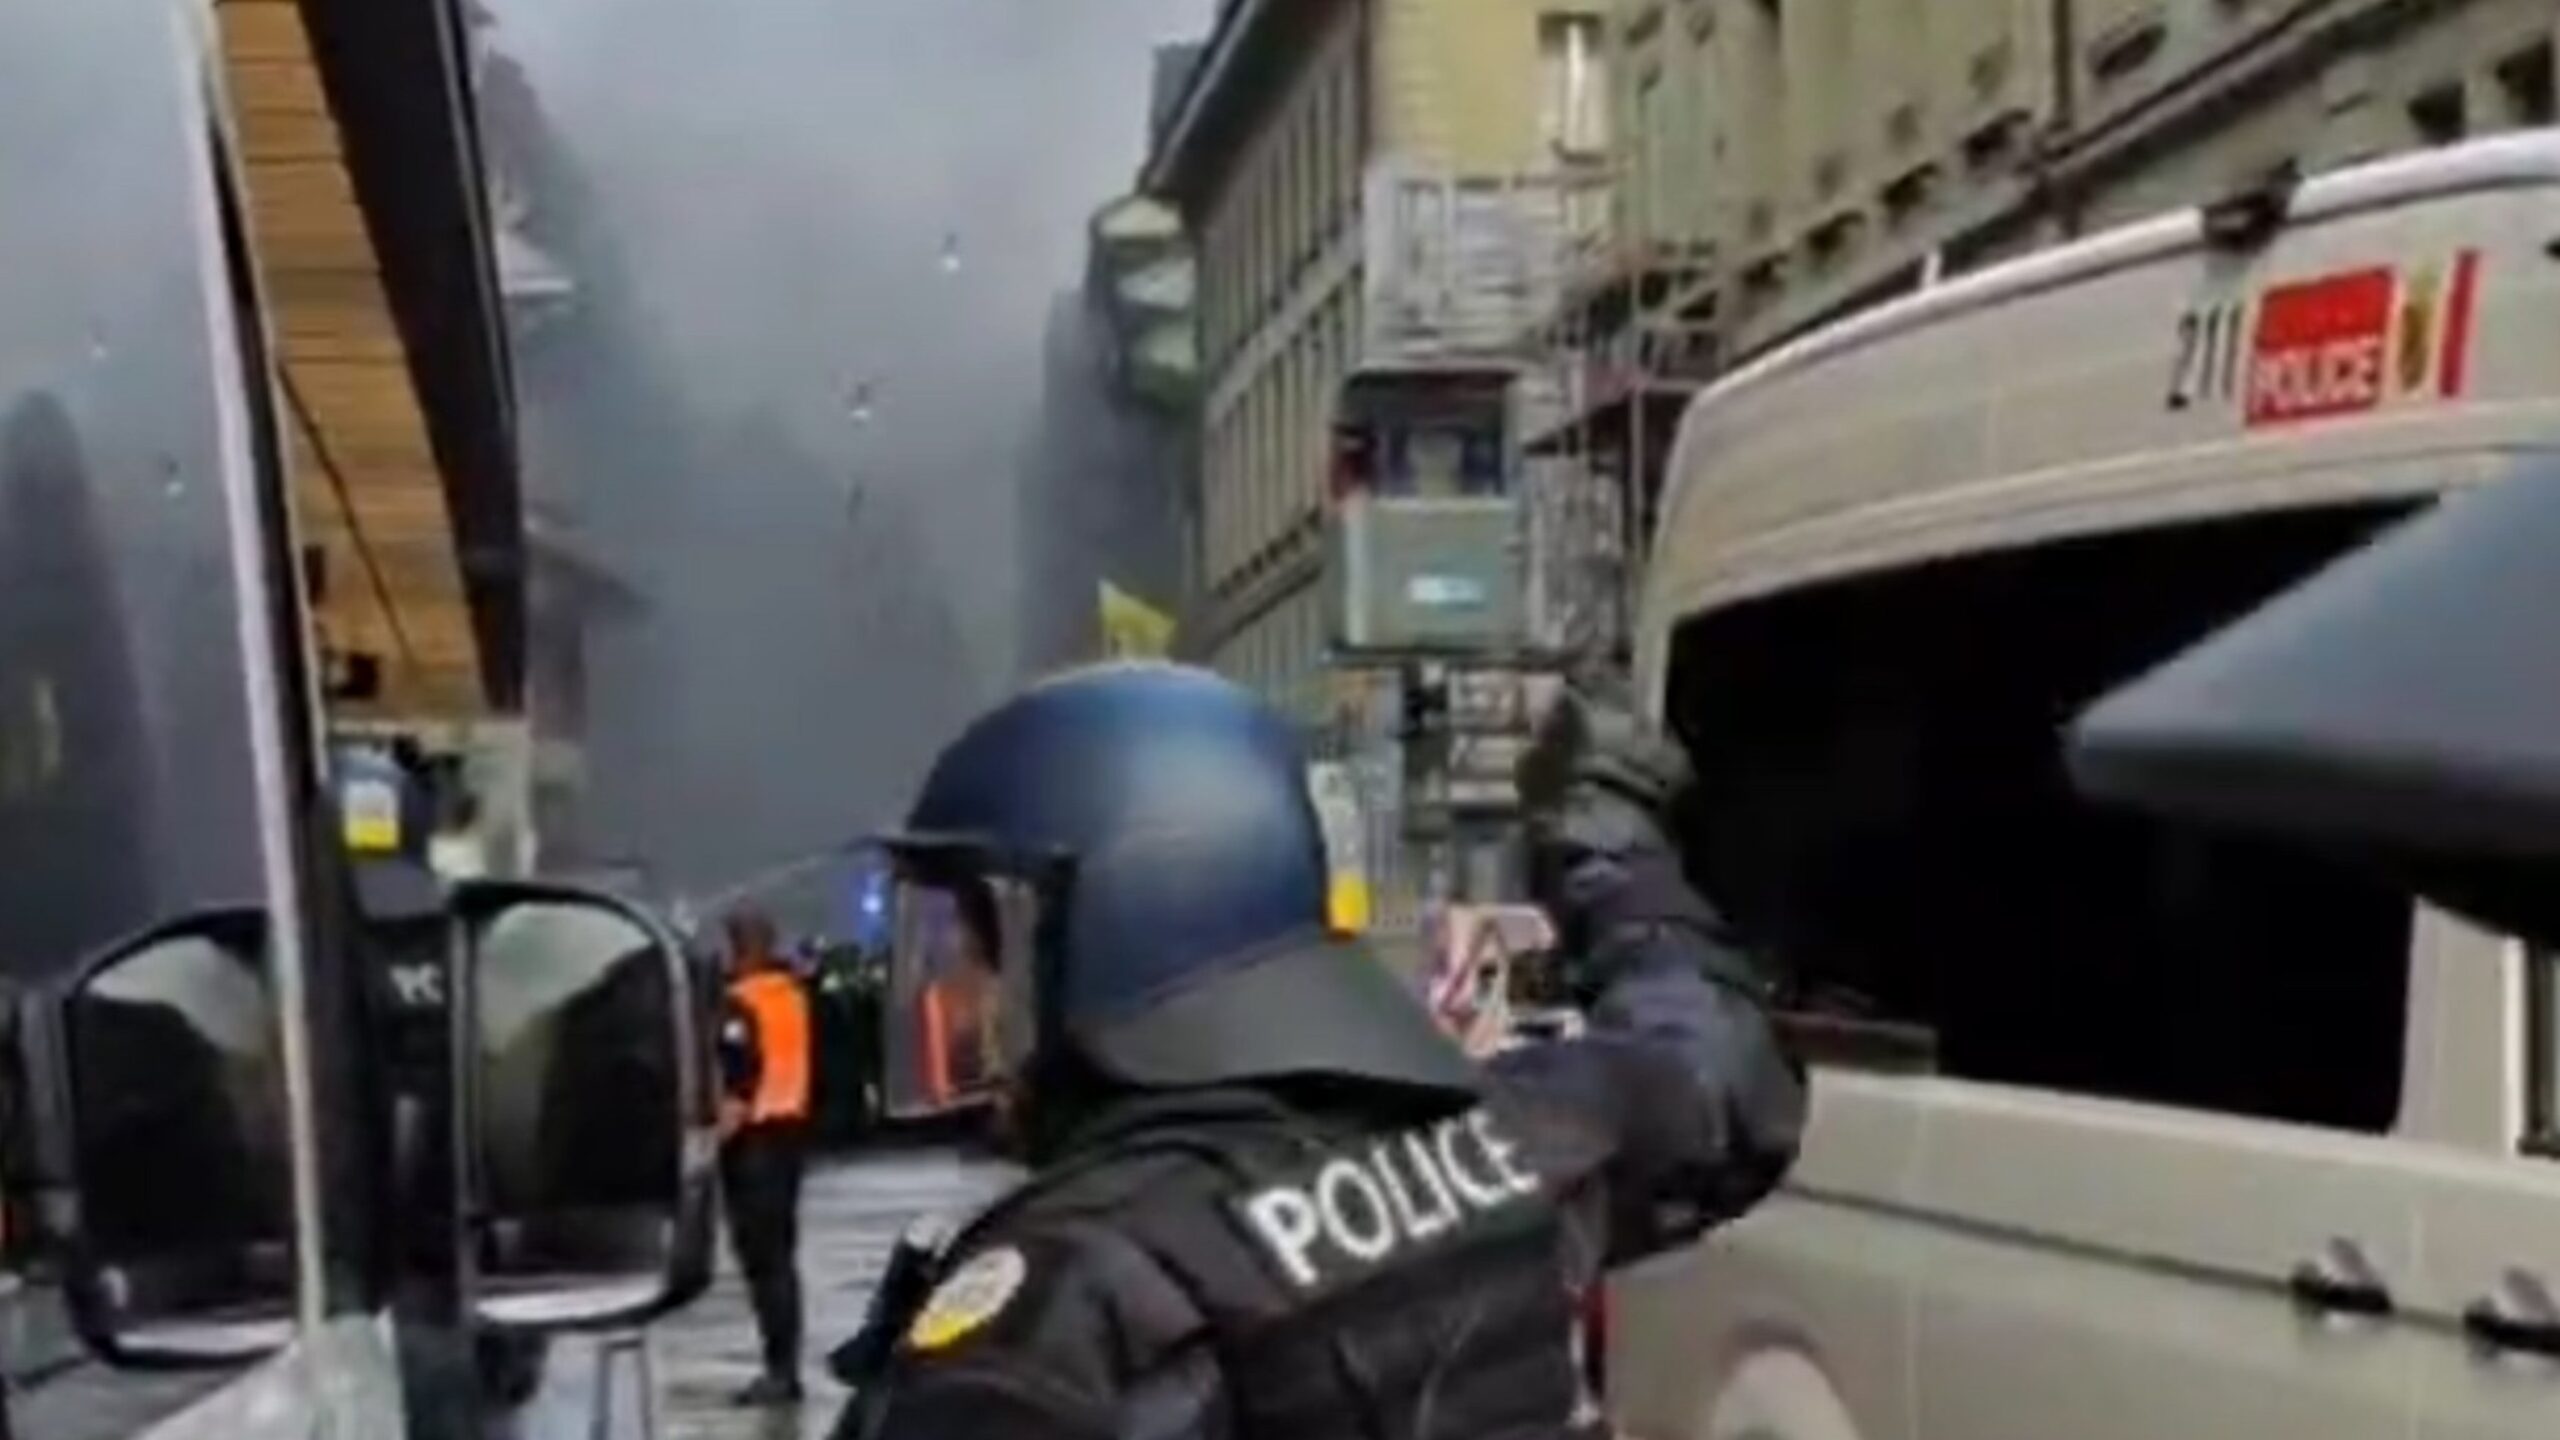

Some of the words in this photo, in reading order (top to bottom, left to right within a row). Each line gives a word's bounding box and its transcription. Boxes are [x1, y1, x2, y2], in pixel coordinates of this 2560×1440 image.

[2168, 307, 2241, 410] 211
[2249, 335, 2382, 410] POLICE
[1248, 1108, 1539, 1285] POLICE
